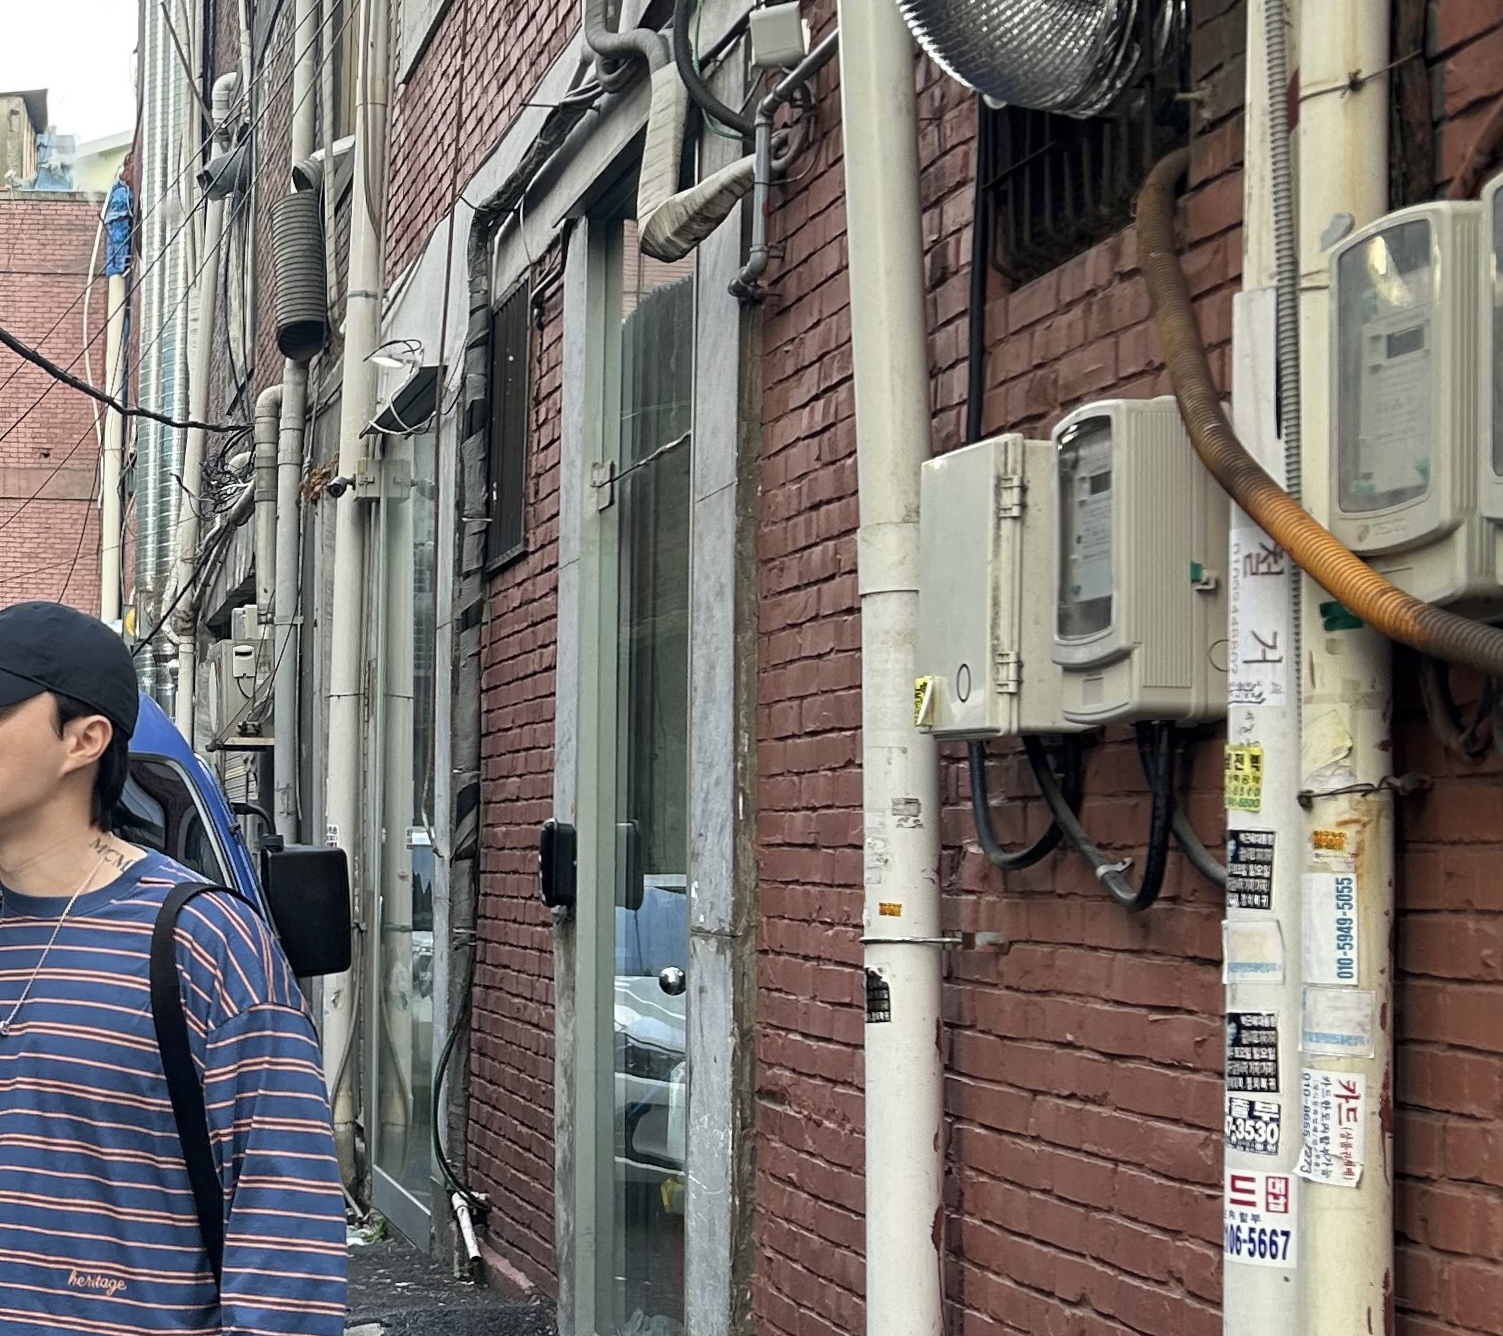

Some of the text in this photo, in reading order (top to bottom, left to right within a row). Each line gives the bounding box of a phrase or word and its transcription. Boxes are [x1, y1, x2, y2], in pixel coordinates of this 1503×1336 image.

[1336, 877, 1354, 979] 010-5949-5055
[1334, 1079, 1362, 1126] 카드
[68, 1268, 127, 1296] heritage
